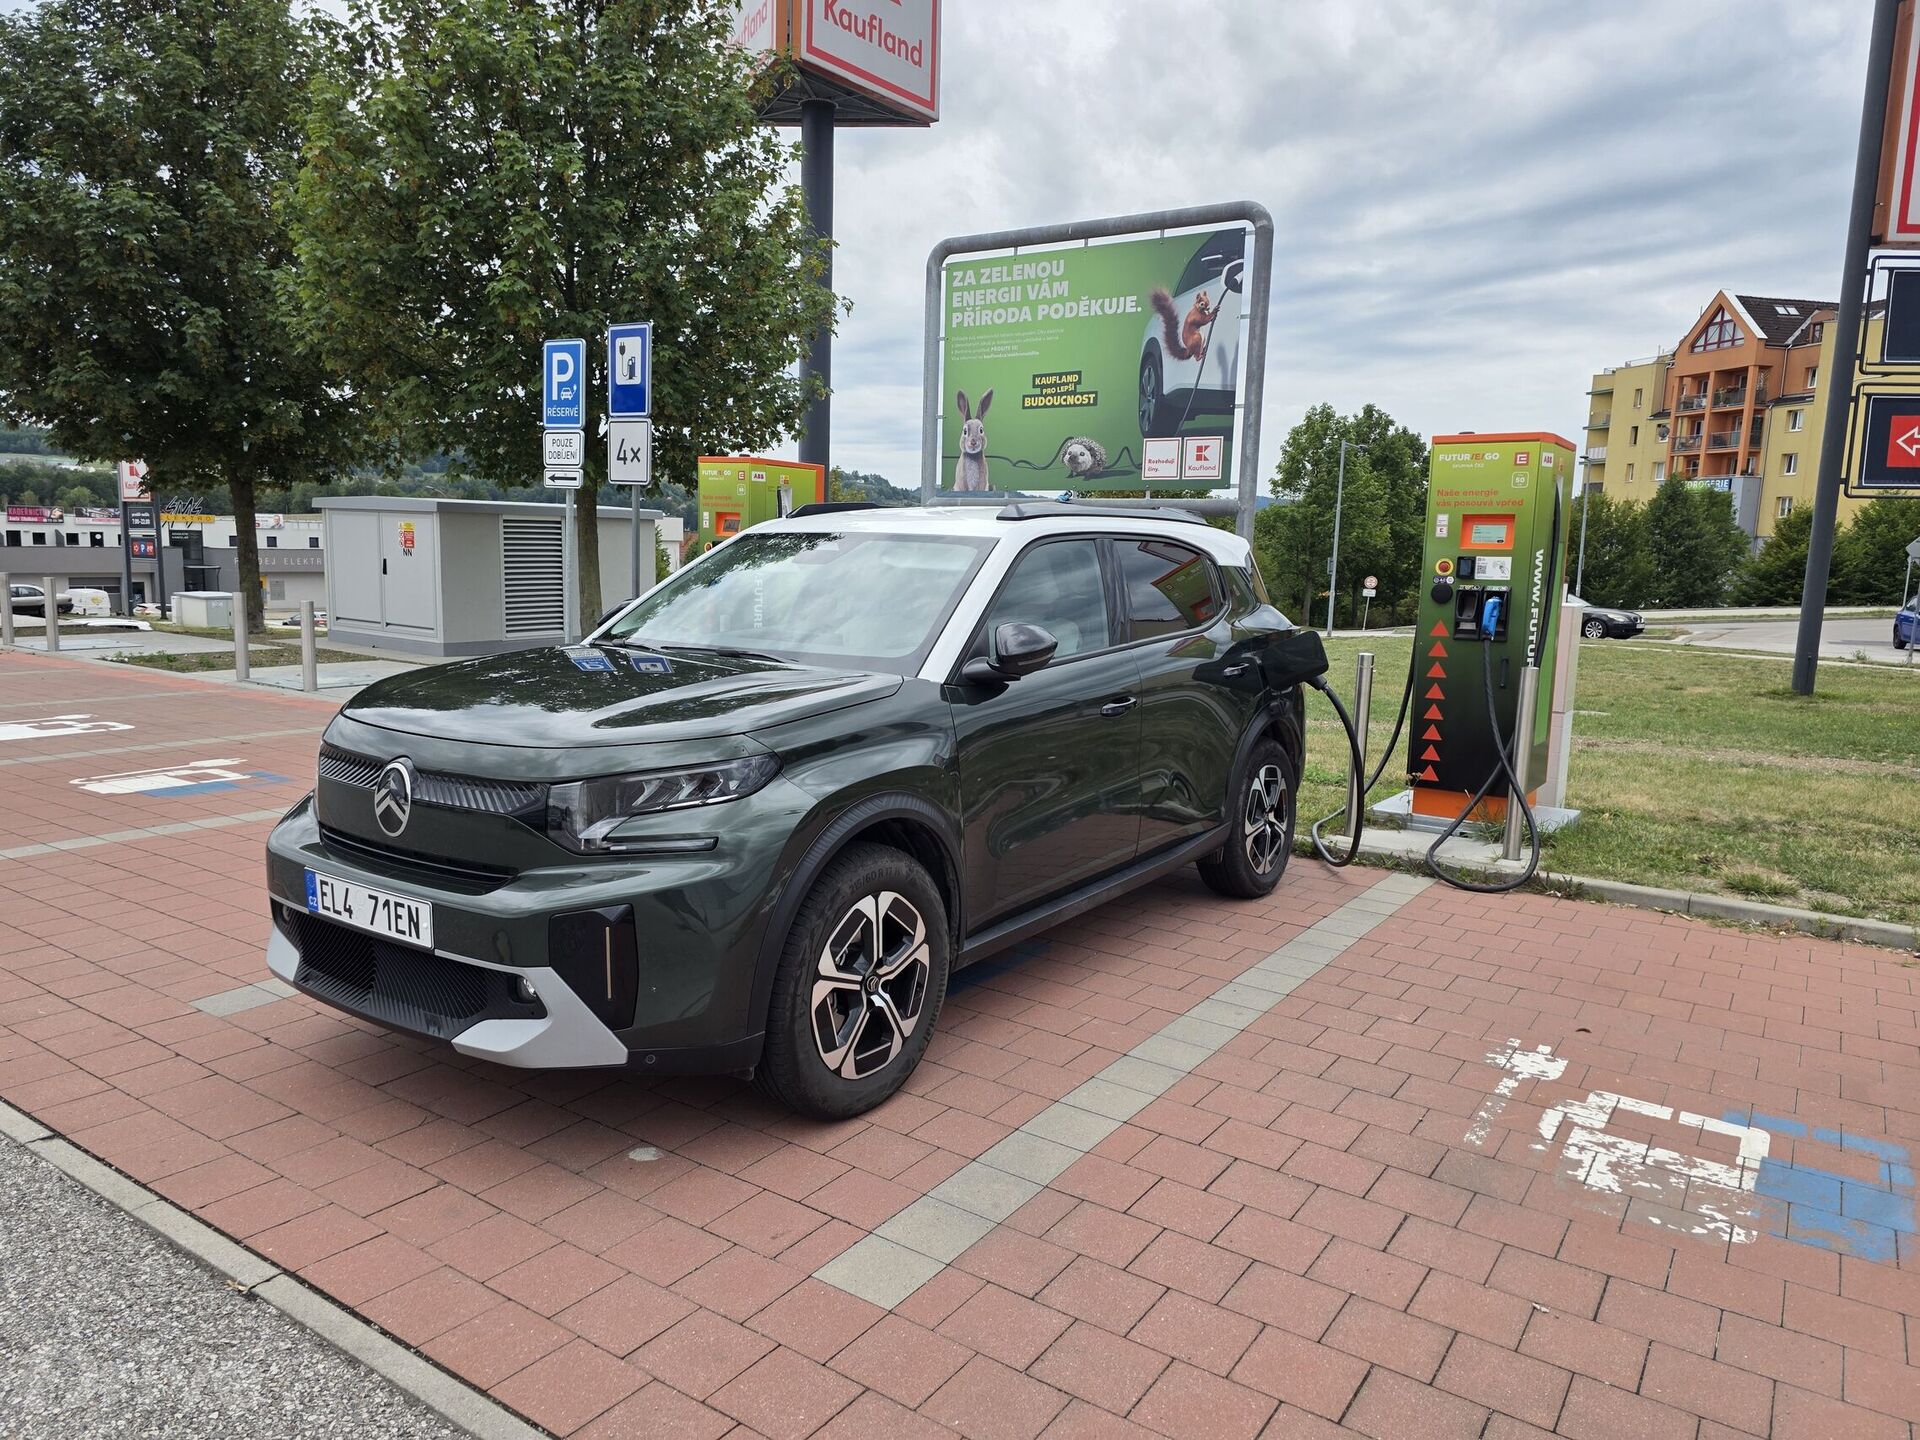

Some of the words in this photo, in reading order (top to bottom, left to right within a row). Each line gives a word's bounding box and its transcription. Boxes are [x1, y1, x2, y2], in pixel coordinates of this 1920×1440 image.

[824, 0, 923, 68] Kaufland
[952, 269, 976, 287] ZA
[980, 259, 1065, 285] ZELENOU
[952, 286, 1022, 308] ENERGII
[1027, 278, 1069, 300] VÁM
[952, 305, 1032, 328] PŘÍRODA
[1037, 295, 1142, 321] PODĚKUJE.
[552, 352, 574, 400] P
[1035, 374, 1079, 385] KAUFLAND
[1042, 387, 1056, 395] PRO
[1057, 383, 1075, 393] LEPŠÍ
[1024, 393, 1096, 407] BUDOUCNOST
[547, 404, 579, 417] RÉSERVÉ
[552, 438, 573, 447] POUZE
[548, 448, 578, 460] DOBÍJENÍ
[616, 438, 641, 465] 4x
[1462, 489, 1499, 498] energie
[402, 548, 413, 557] NN
[283, 557, 322, 566] ELEKTR
[319, 878, 353, 920] EL4
[367, 893, 421, 940] 71EN
